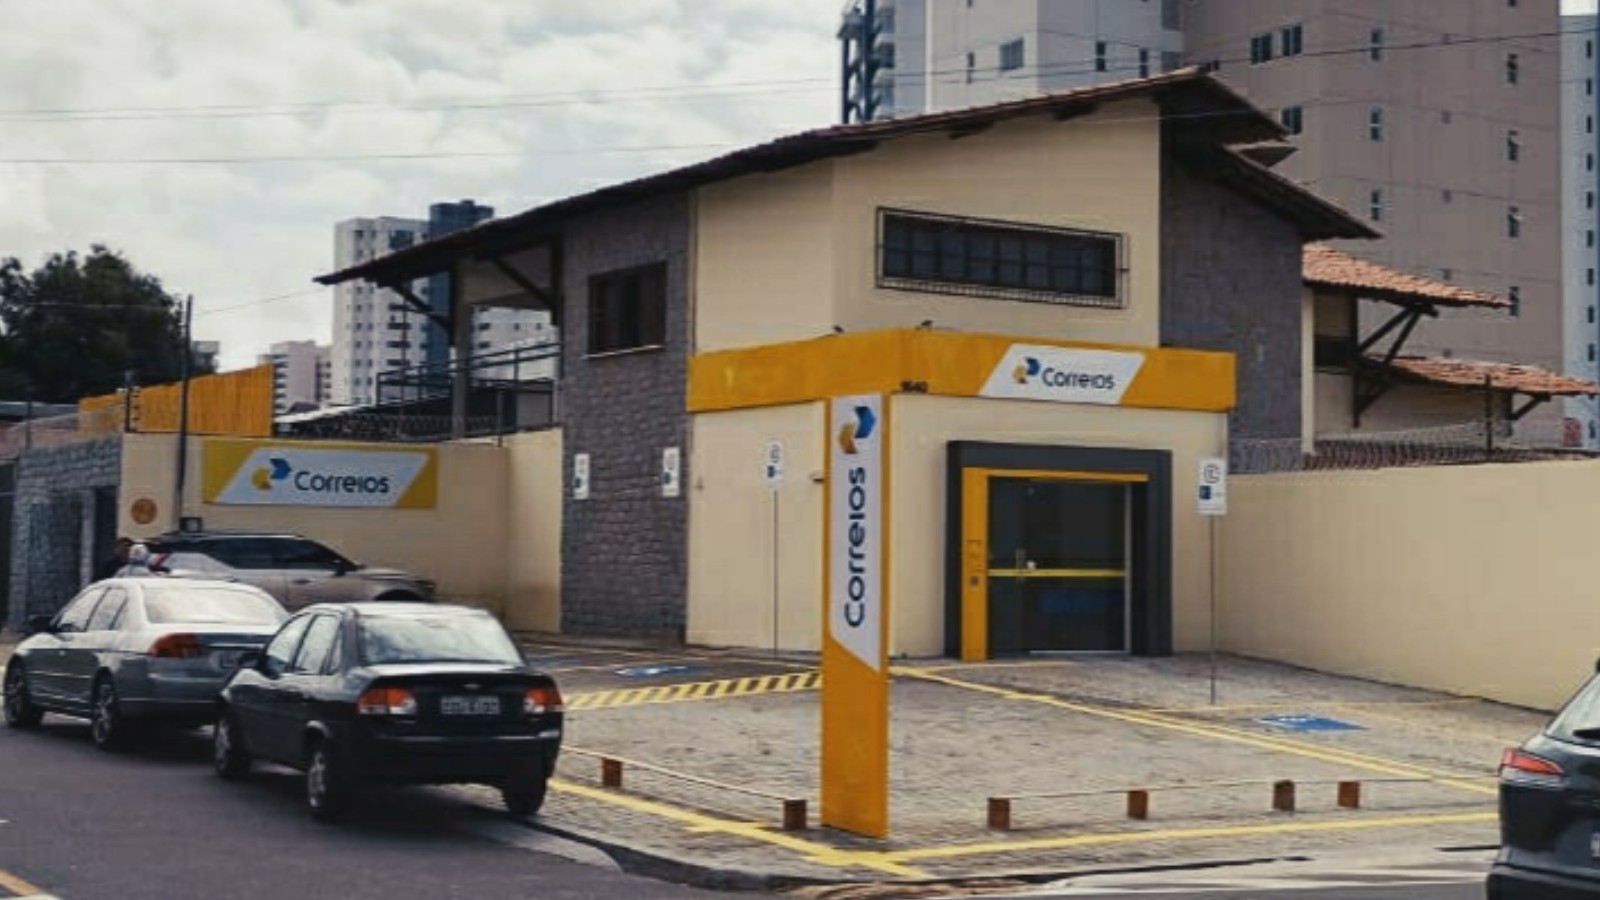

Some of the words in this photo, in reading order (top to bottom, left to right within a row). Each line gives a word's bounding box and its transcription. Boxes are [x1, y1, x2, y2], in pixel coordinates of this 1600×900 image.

[1042, 367, 1115, 389] Correios
[294, 470, 390, 493] Correios
[844, 467, 866, 628] Correios
